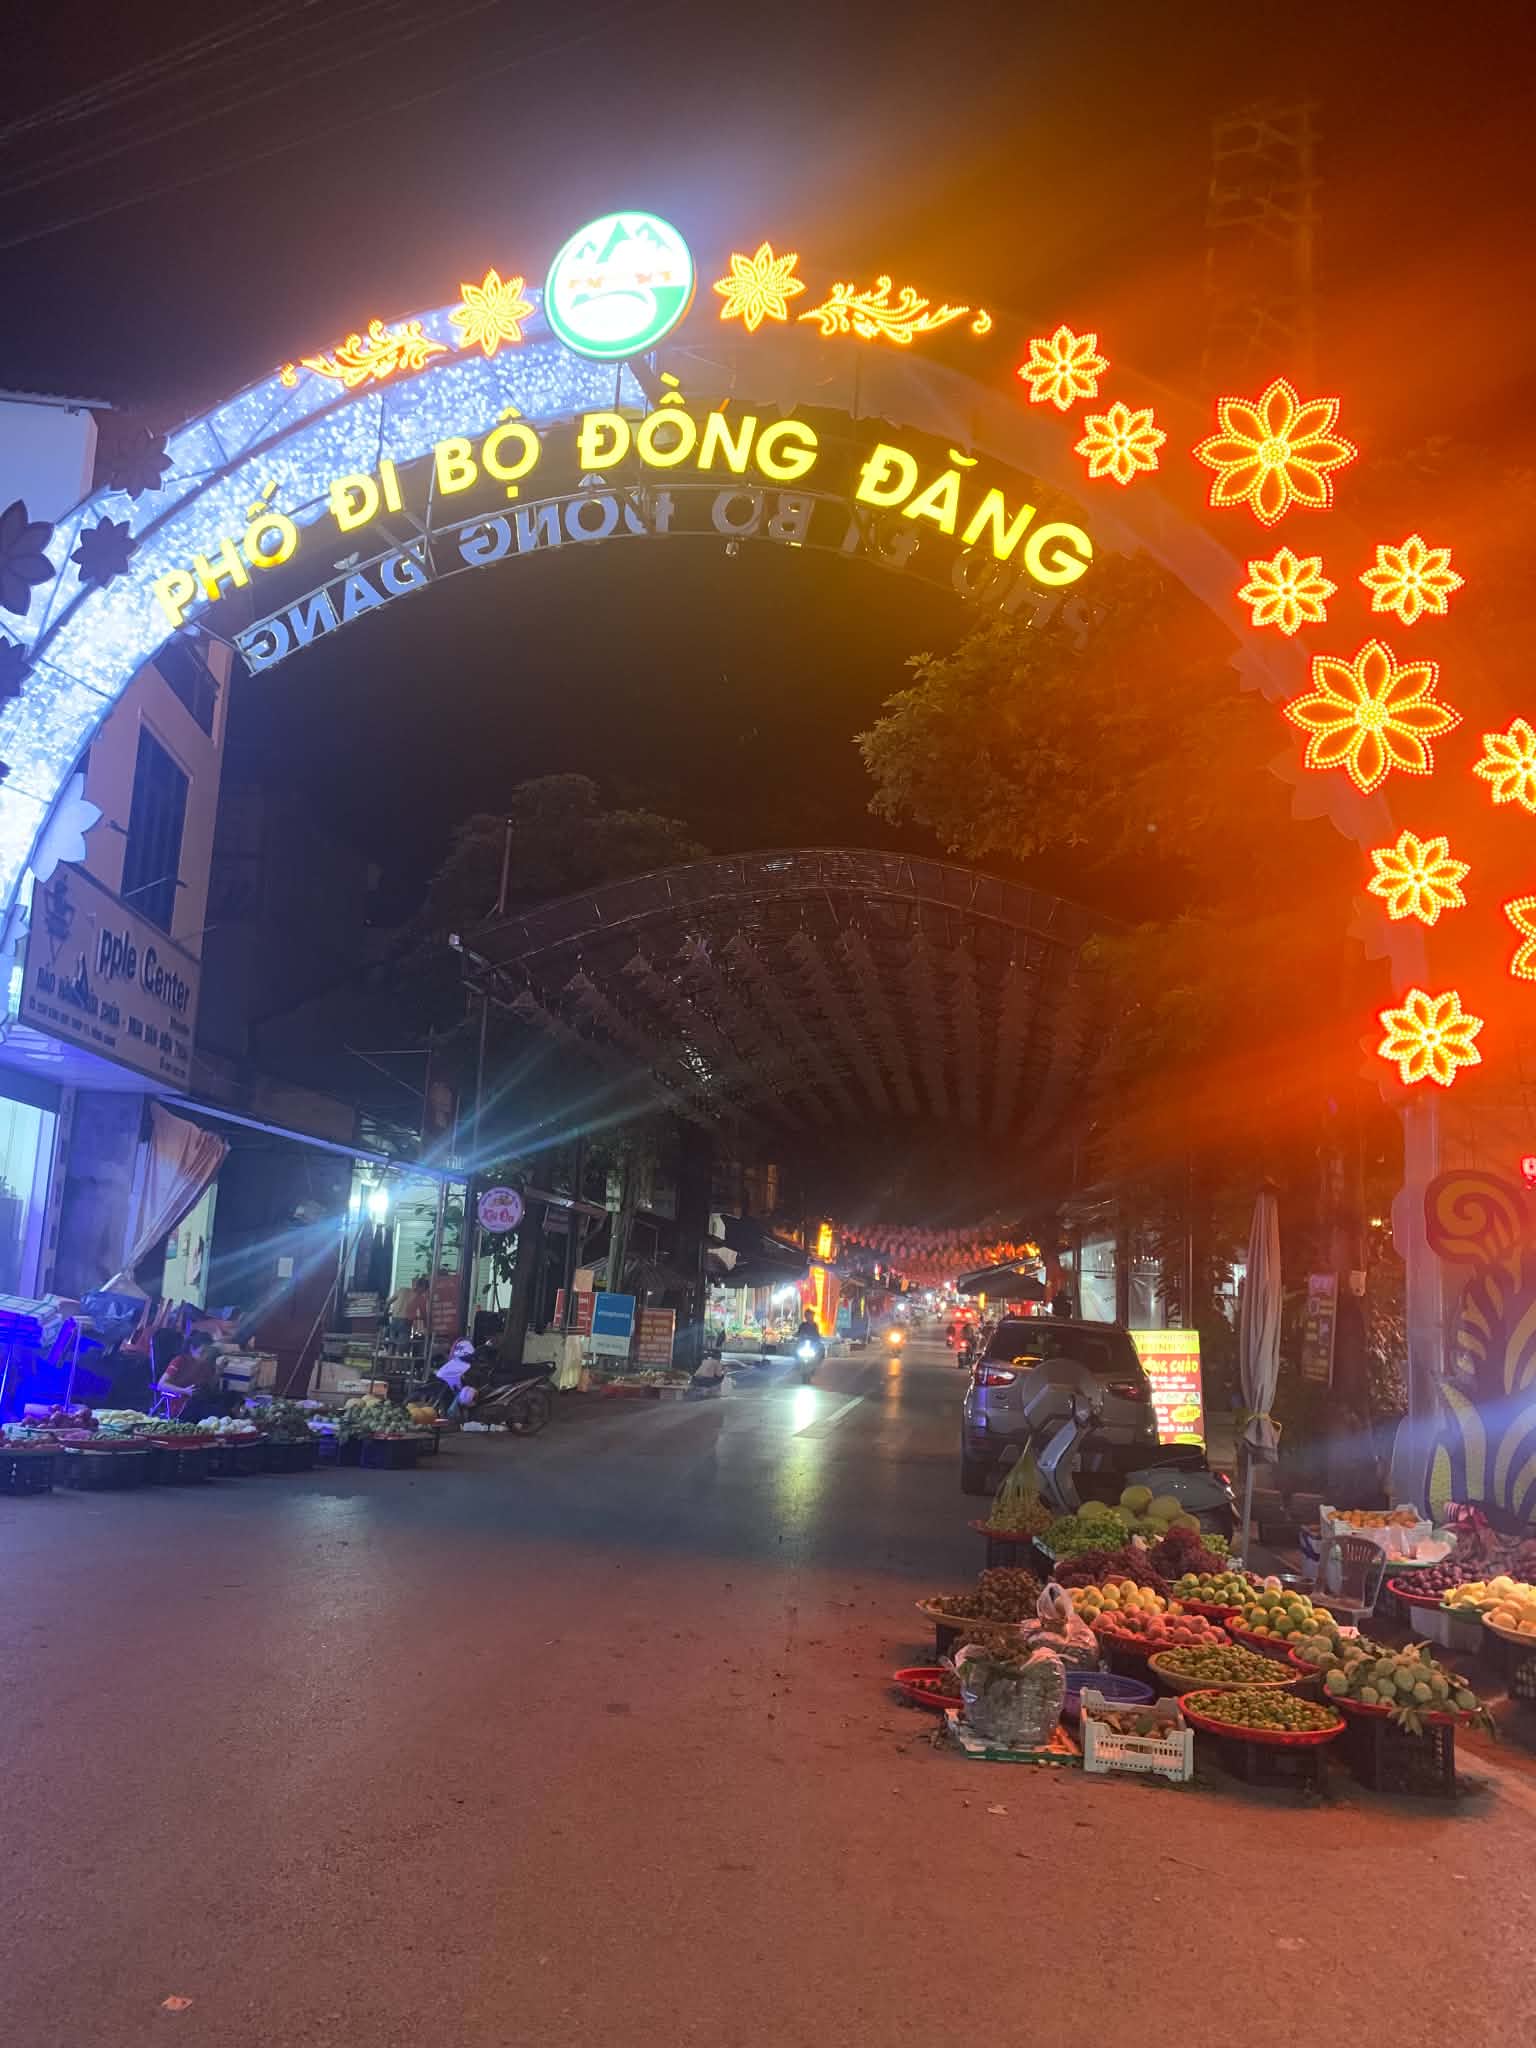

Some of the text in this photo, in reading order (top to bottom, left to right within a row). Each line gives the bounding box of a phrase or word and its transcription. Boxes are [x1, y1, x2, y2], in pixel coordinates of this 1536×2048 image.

[153, 371, 1094, 629] PHỐ ĐI BỘ ĐỒNG ĐĂNG
[143, 945, 190, 1014] Center
